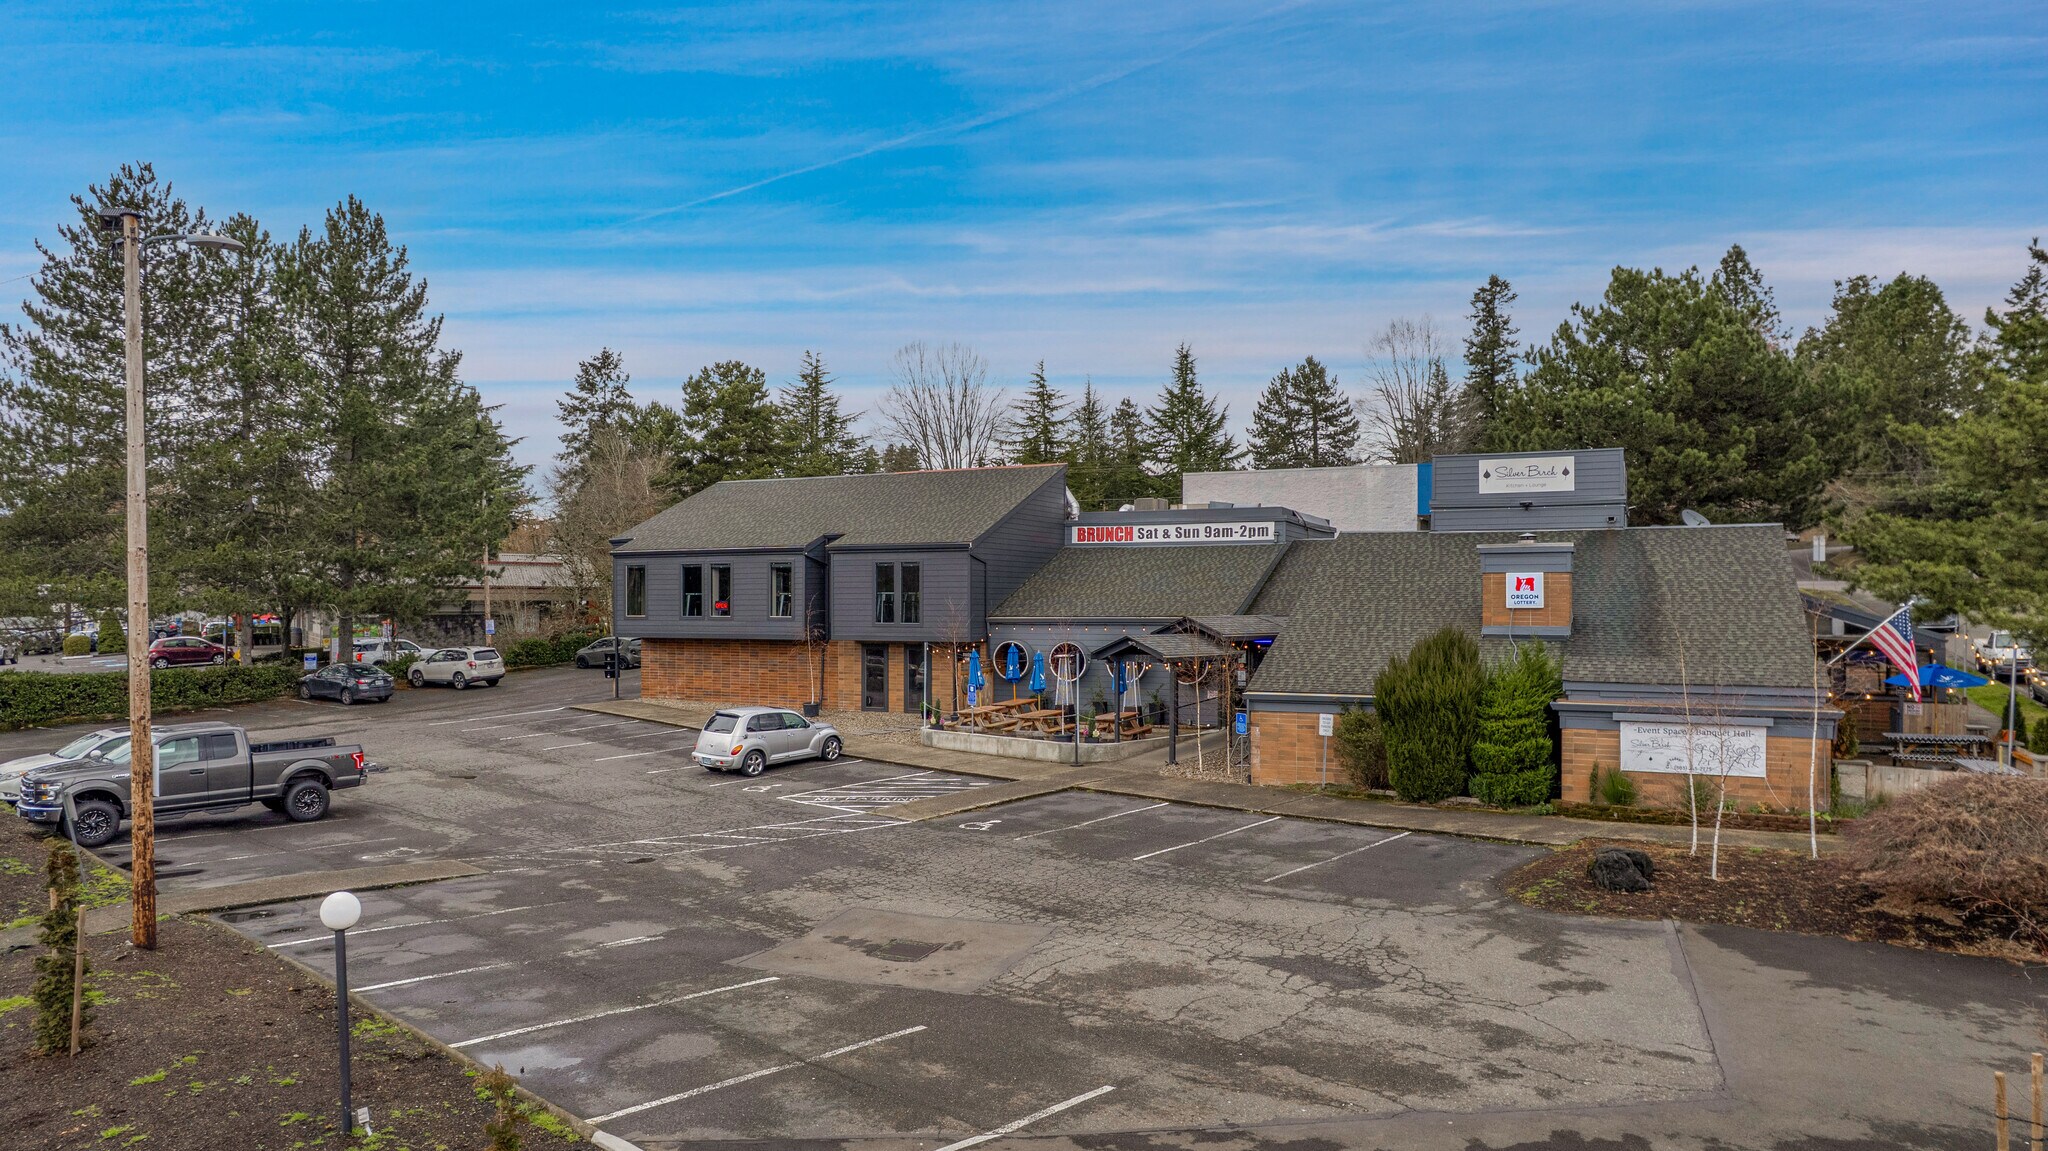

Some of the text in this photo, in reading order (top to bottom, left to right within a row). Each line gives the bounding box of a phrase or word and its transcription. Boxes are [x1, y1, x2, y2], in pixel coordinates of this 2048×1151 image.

[1494, 464, 1558, 478] Silver Birch
[1077, 525, 1269, 542] BRUNCH Sat & Sun 9am-2pm
[1663, 727, 1688, 736] Space
